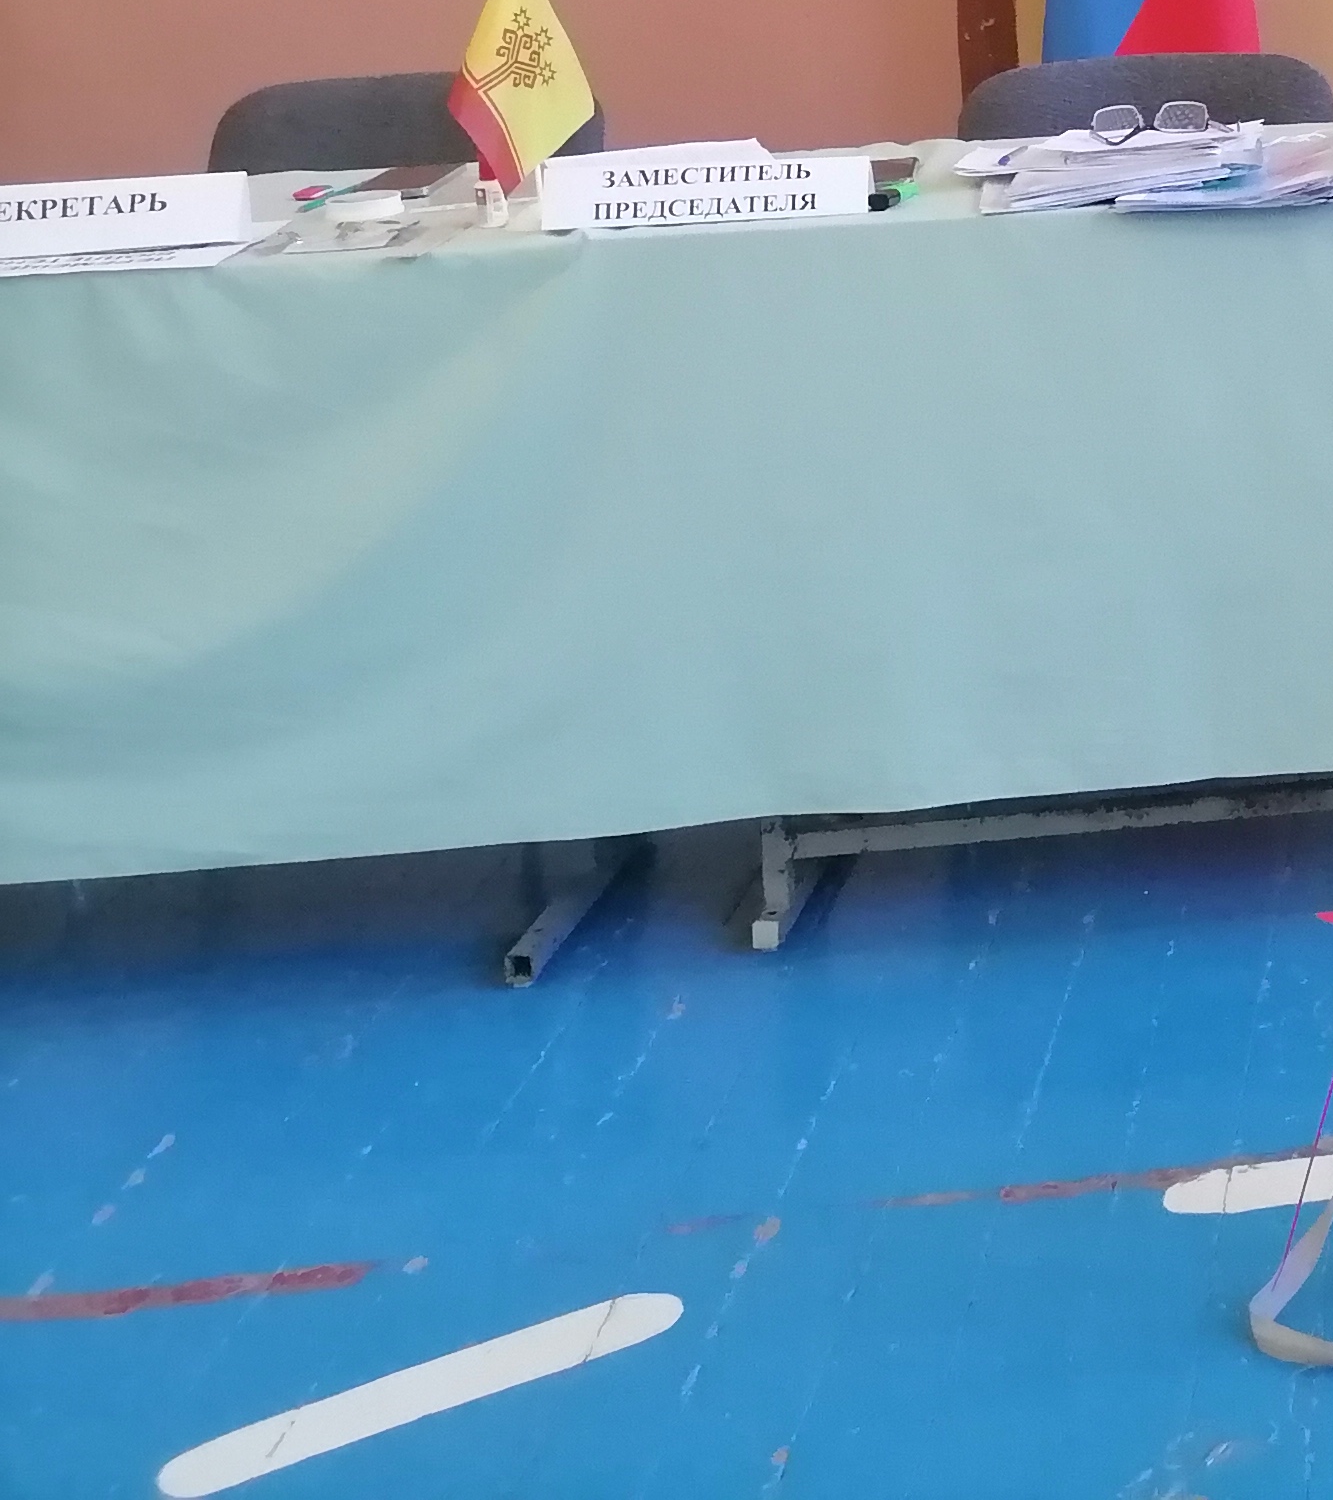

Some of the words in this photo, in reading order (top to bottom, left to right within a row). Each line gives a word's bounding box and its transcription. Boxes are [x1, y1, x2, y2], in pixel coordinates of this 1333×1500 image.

[602, 162, 812, 189] ЗАМЕСТИТЕЛЬ
[0, 192, 168, 223] ЕКРЕТАРЬ
[593, 192, 817, 222] ПРЕДСЕДАТЕЛЯ
